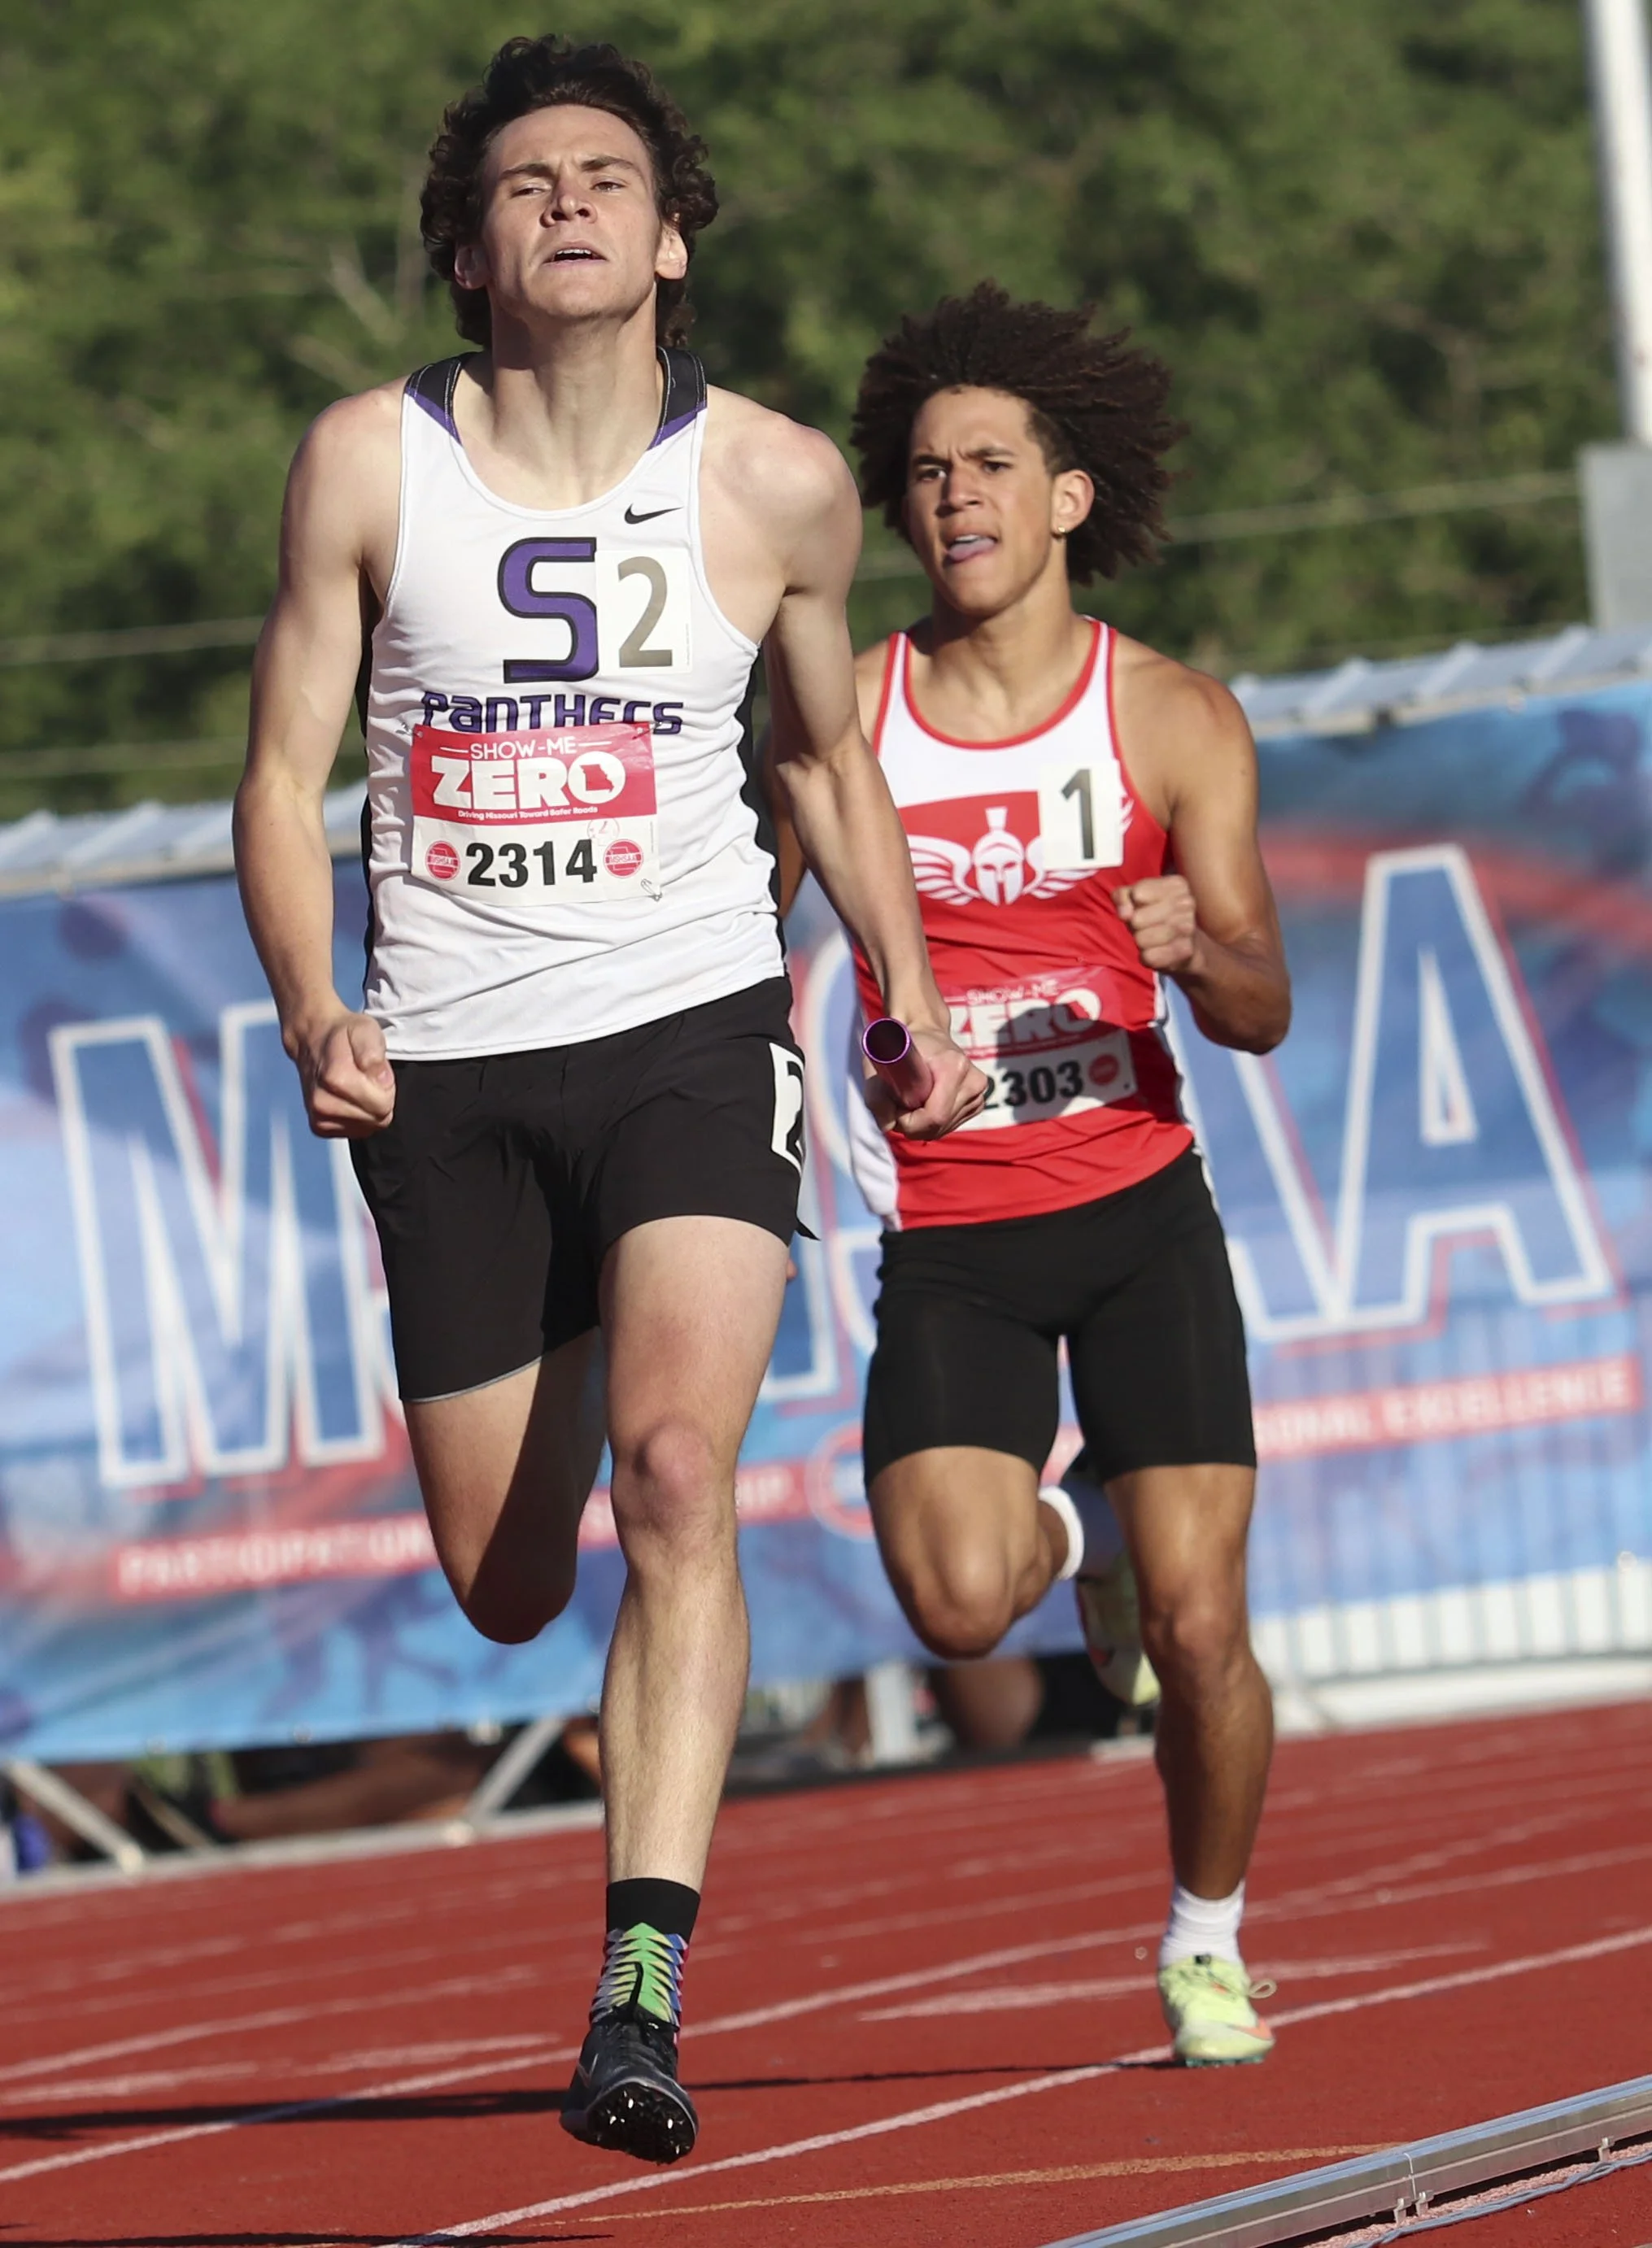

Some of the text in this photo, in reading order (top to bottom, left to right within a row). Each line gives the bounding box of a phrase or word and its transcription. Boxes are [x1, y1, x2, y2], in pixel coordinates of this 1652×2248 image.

[497, 537, 599, 684] S
[617, 555, 673, 668] 2
[469, 736, 577, 760] SHOW-ME
[431, 751, 626, 810] ZERO
[457, 806, 598, 821] Driving Missouri Toward Safer Roads
[1061, 769, 1095, 860] 1
[465, 839, 598, 888] 2314
[965, 979, 1058, 1004] SHOW-ME
